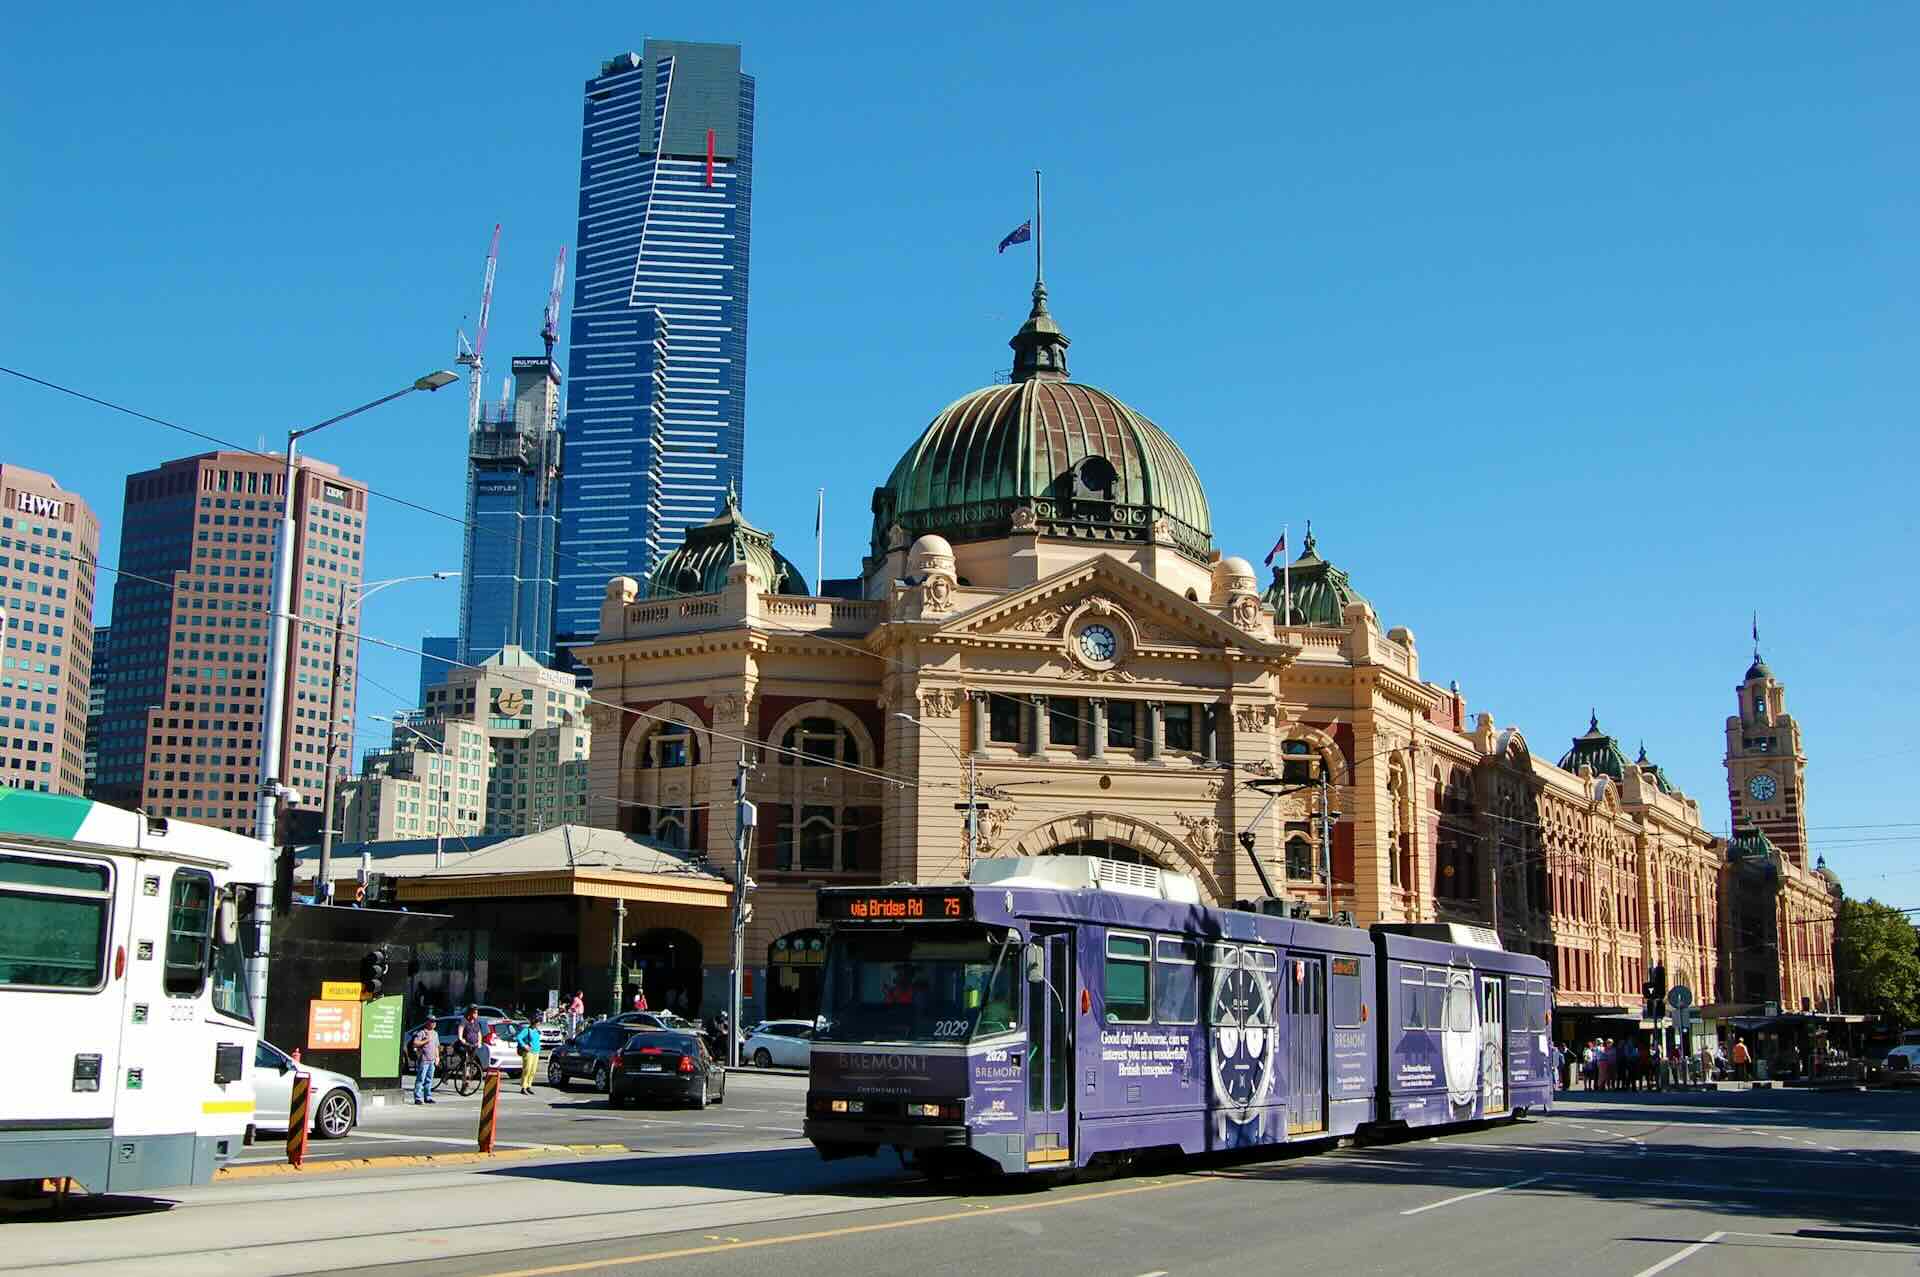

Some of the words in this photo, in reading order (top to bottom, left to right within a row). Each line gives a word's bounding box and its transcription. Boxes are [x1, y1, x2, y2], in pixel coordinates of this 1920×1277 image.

[18, 492, 63, 518] HWT
[851, 899, 868, 917] via
[869, 899, 906, 916] Bridge
[908, 899, 923, 916] Rd
[944, 898, 960, 916] 75
[933, 1020, 969, 1036] 2029
[1101, 1030, 1120, 1045] Good
[1121, 1031, 1133, 1048] day
[1168, 1034, 1180, 1045] can
[1180, 1034, 1190, 1045] we
[840, 1055, 929, 1073] BREMONT
[985, 1050, 1008, 1062] 2029
[975, 1066, 1022, 1078] BREMONT
